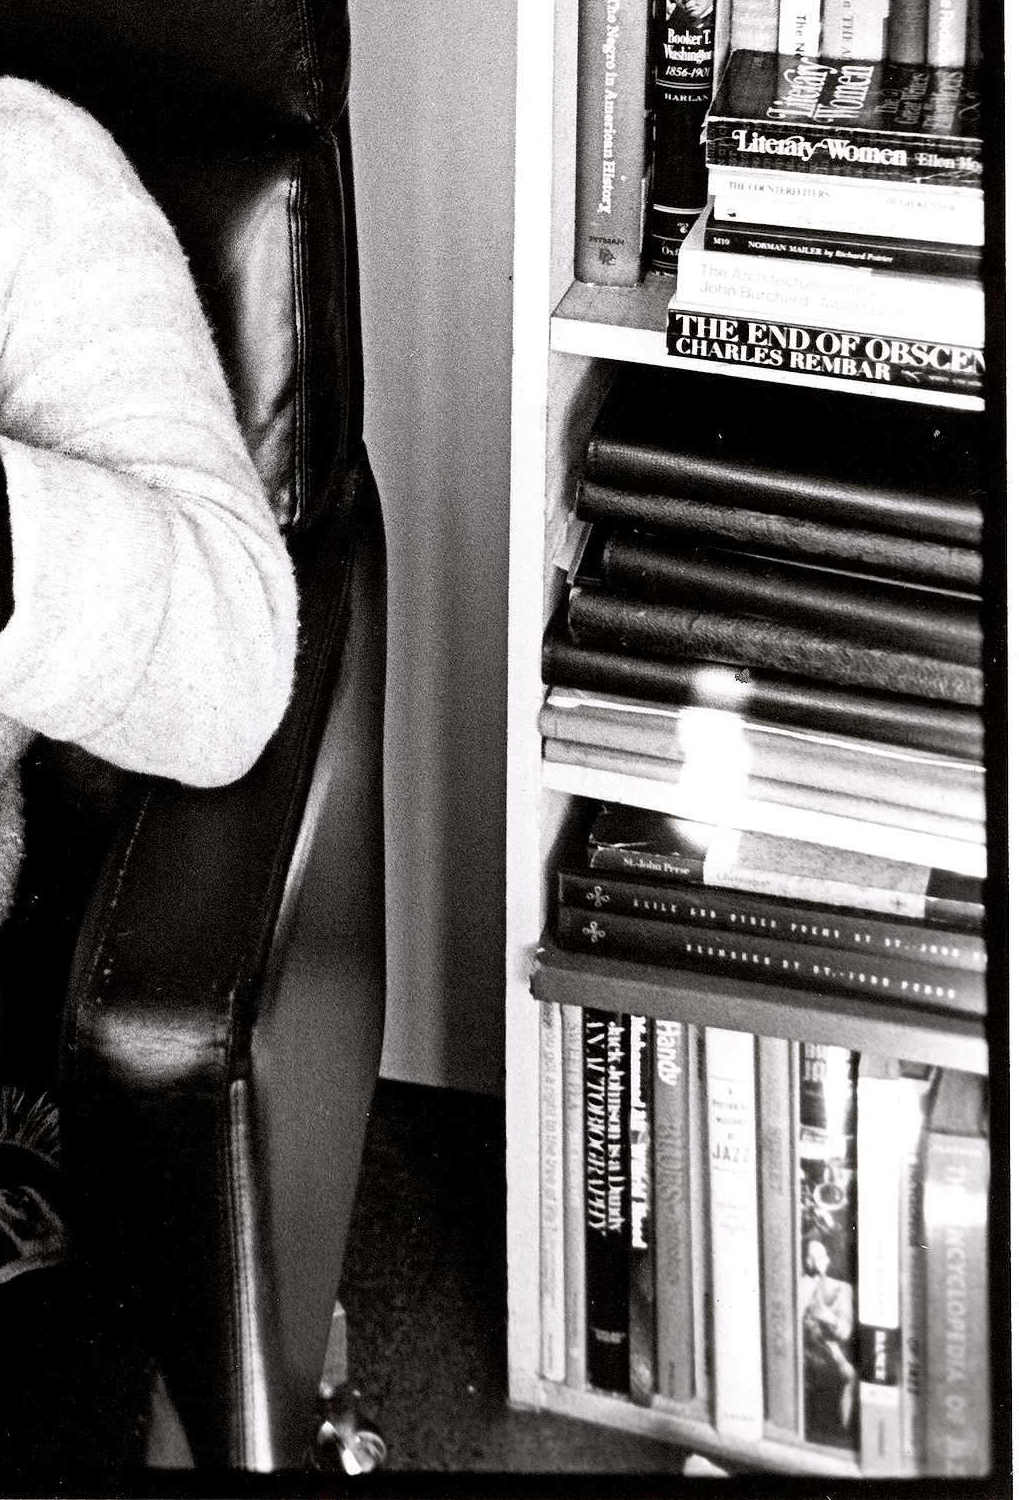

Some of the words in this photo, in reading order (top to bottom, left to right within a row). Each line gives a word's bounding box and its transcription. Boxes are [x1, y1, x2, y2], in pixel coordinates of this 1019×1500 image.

[667, 27, 703, 45] Booker
[702, 29, 712, 45] T.
[795, 15, 807, 37] The
[841, 16, 854, 41] THE
[603, 24, 620, 72] Negro
[664, 92, 709, 102] HARLAN
[766, 56, 838, 119] Literary
[813, 64, 876, 122] Women
[602, 90, 616, 156] American
[731, 129, 815, 161] Literary
[814, 138, 908, 167] Women
[916, 152, 957, 170] Ellen
[958, 158, 983, 172] Mo
[597, 160, 614, 214] History
[588, 235, 625, 246] PITMAN
[661, 245, 680, 257] Oxf
[748, 240, 787, 252] NORMAN
[788, 244, 822, 257] MAILER
[823, 247, 835, 258] by
[835, 249, 868, 261] Richard
[699, 281, 737, 297] John
[700, 263, 729, 278] The
[675, 337, 783, 365] CHARLES
[790, 346, 892, 382] REMBAR
[676, 314, 739, 343] THE
[748, 322, 811, 352] END
[816, 331, 860, 357] OF
[865, 338, 984, 377] OBSCEN
[663, 861, 691, 876] Perse
[586, 1020, 606, 1049] AN
[607, 1021, 626, 1062] Jack
[656, 1019, 682, 1086] Handy
[607, 1065, 626, 1140] Johnson
[586, 1057, 607, 1237] AUTOBIOGRAPHY
[711, 1143, 751, 1164] JAZZ
[605, 1175, 626, 1232] Dandy
[943, 1227, 967, 1383] NCYCLOPEDIA
